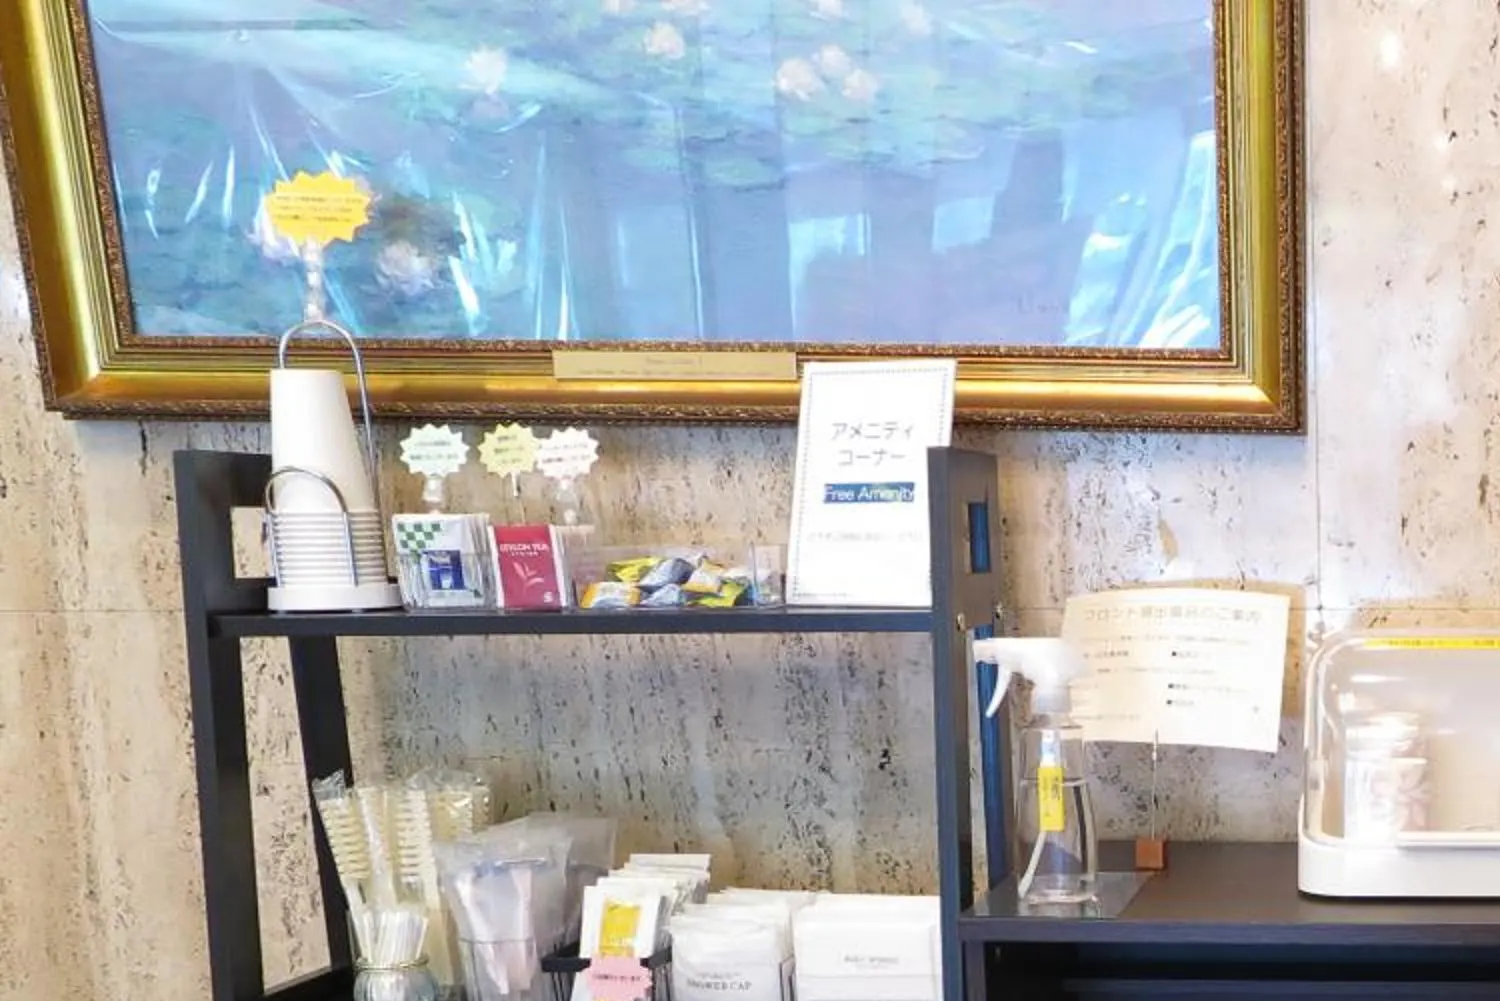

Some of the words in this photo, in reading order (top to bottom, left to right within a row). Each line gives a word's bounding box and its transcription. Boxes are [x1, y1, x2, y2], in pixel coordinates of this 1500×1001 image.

[830, 421, 915, 441] アメニティ
[837, 449, 907, 467] コーナー
[824, 485, 855, 502] Free
[857, 484, 915, 503] Amenity
[729, 980, 753, 991] CAP
